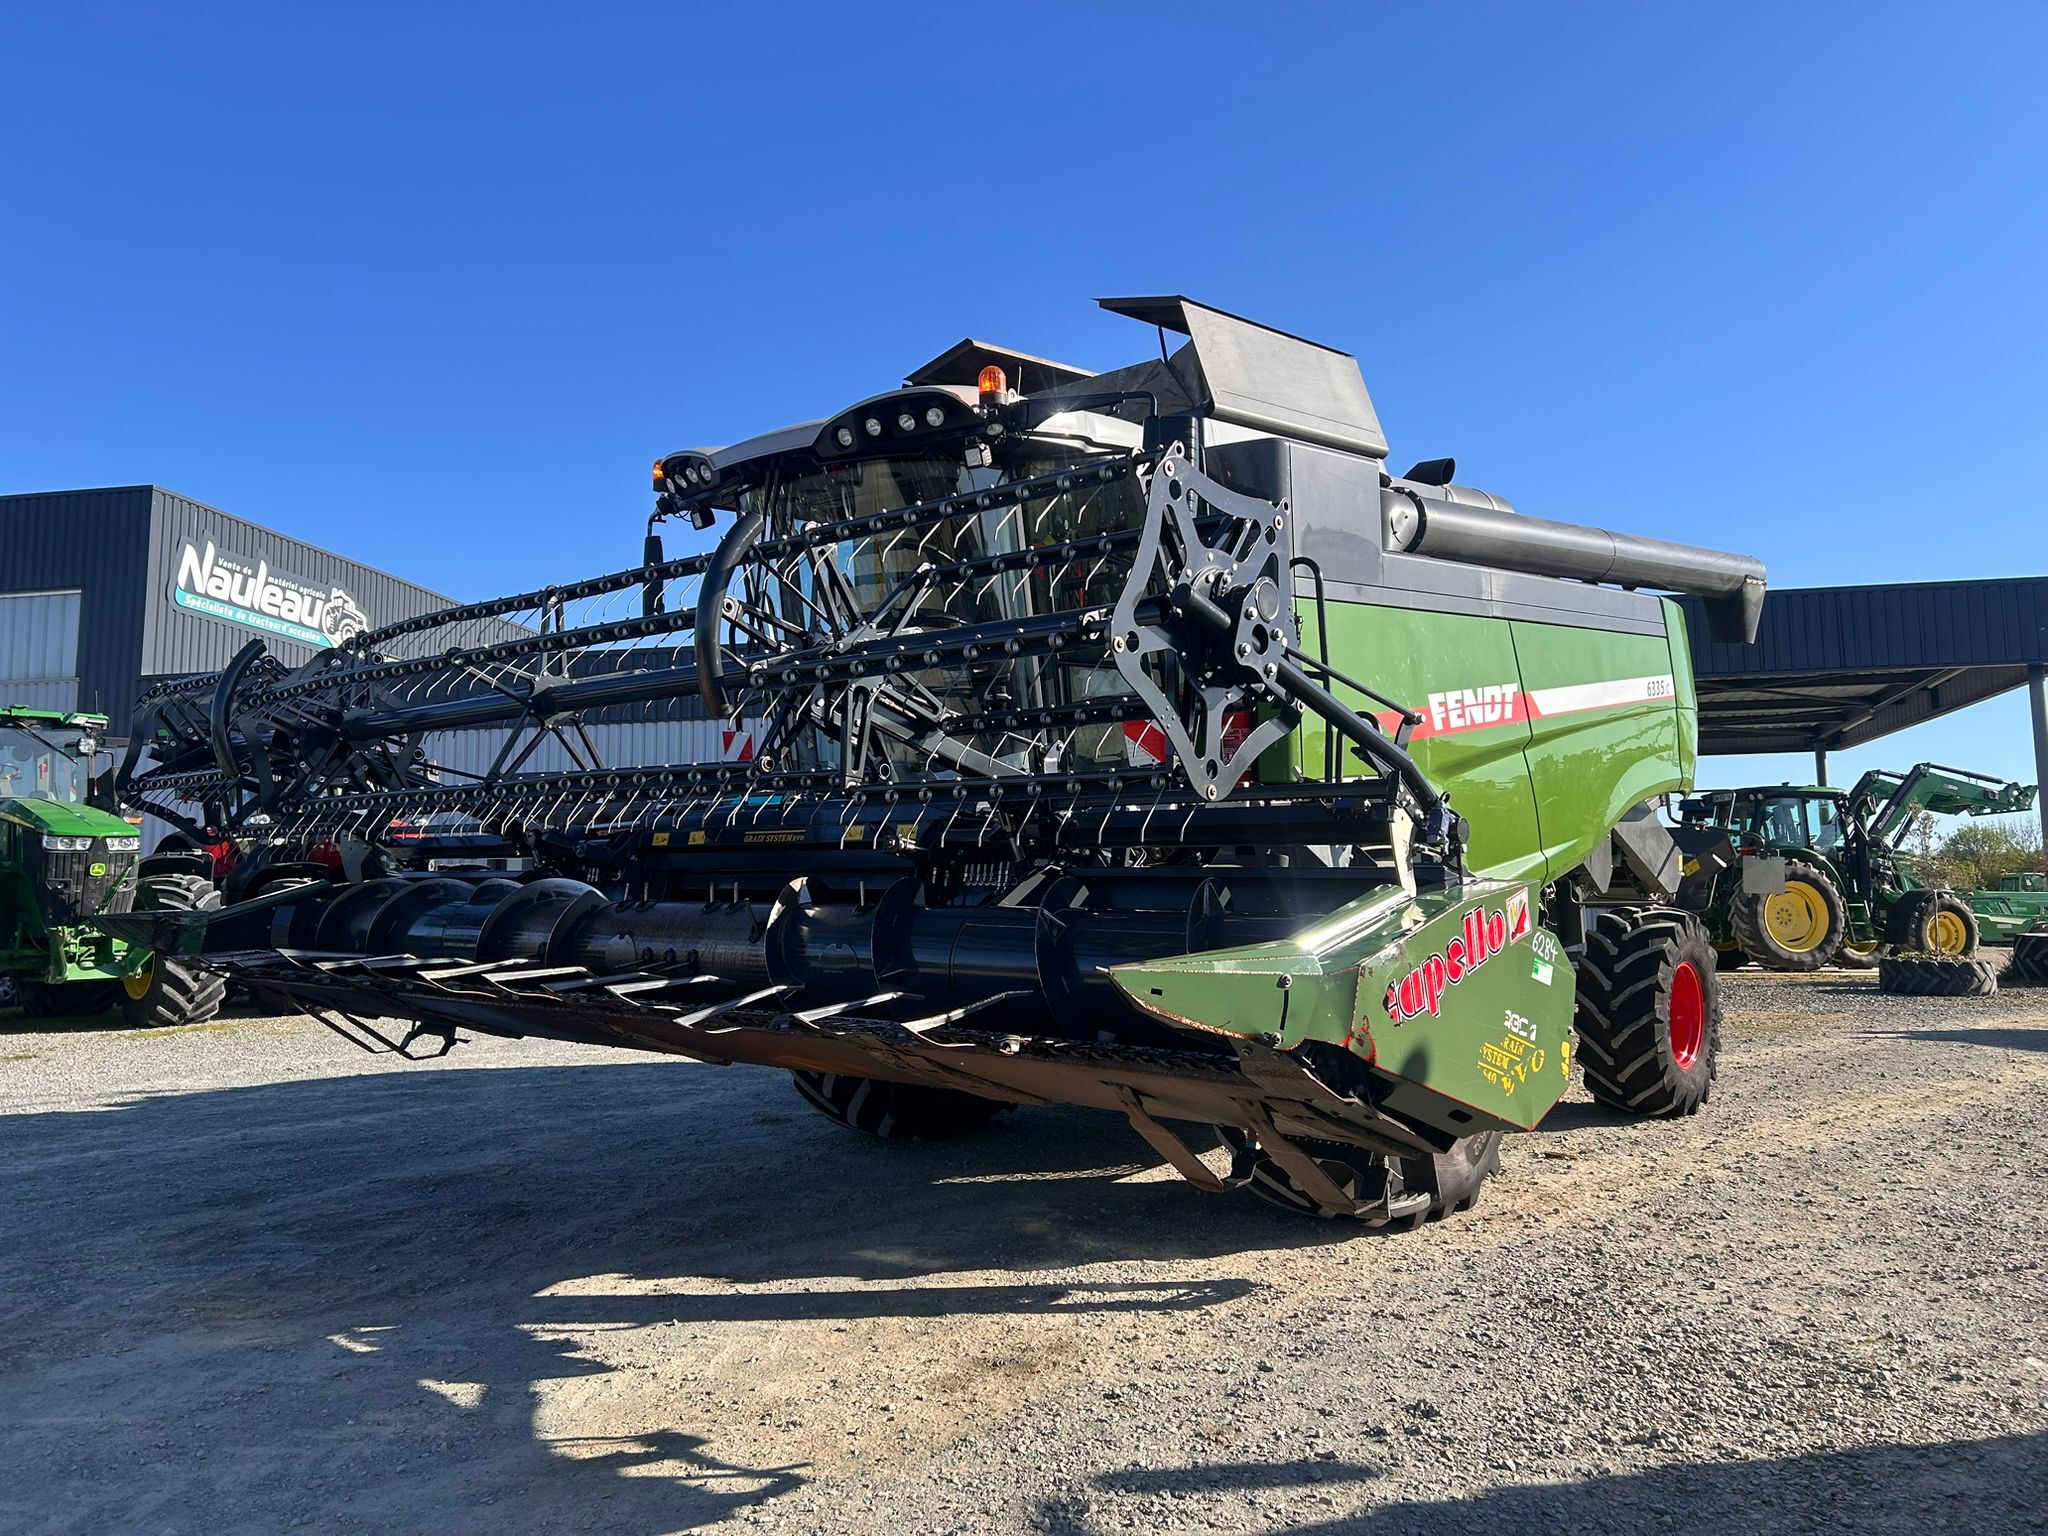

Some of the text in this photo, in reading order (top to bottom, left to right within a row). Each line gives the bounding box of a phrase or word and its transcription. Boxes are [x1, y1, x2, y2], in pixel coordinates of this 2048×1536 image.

[218, 557, 253, 576] Vente de
[177, 540, 325, 629] Nauleau
[184, 595, 234, 618] Spécialiste
[236, 609, 247, 621] du
[1646, 679, 1665, 698] 6335
[1427, 682, 1520, 731] FENDT
[744, 835, 766, 843] GRAIN
[766, 834, 793, 842] SYSTEM
[1532, 931, 1559, 962] 6284
[1479, 1046, 1510, 1070] YSTEM
[1501, 1037, 1525, 1056] RAIN
